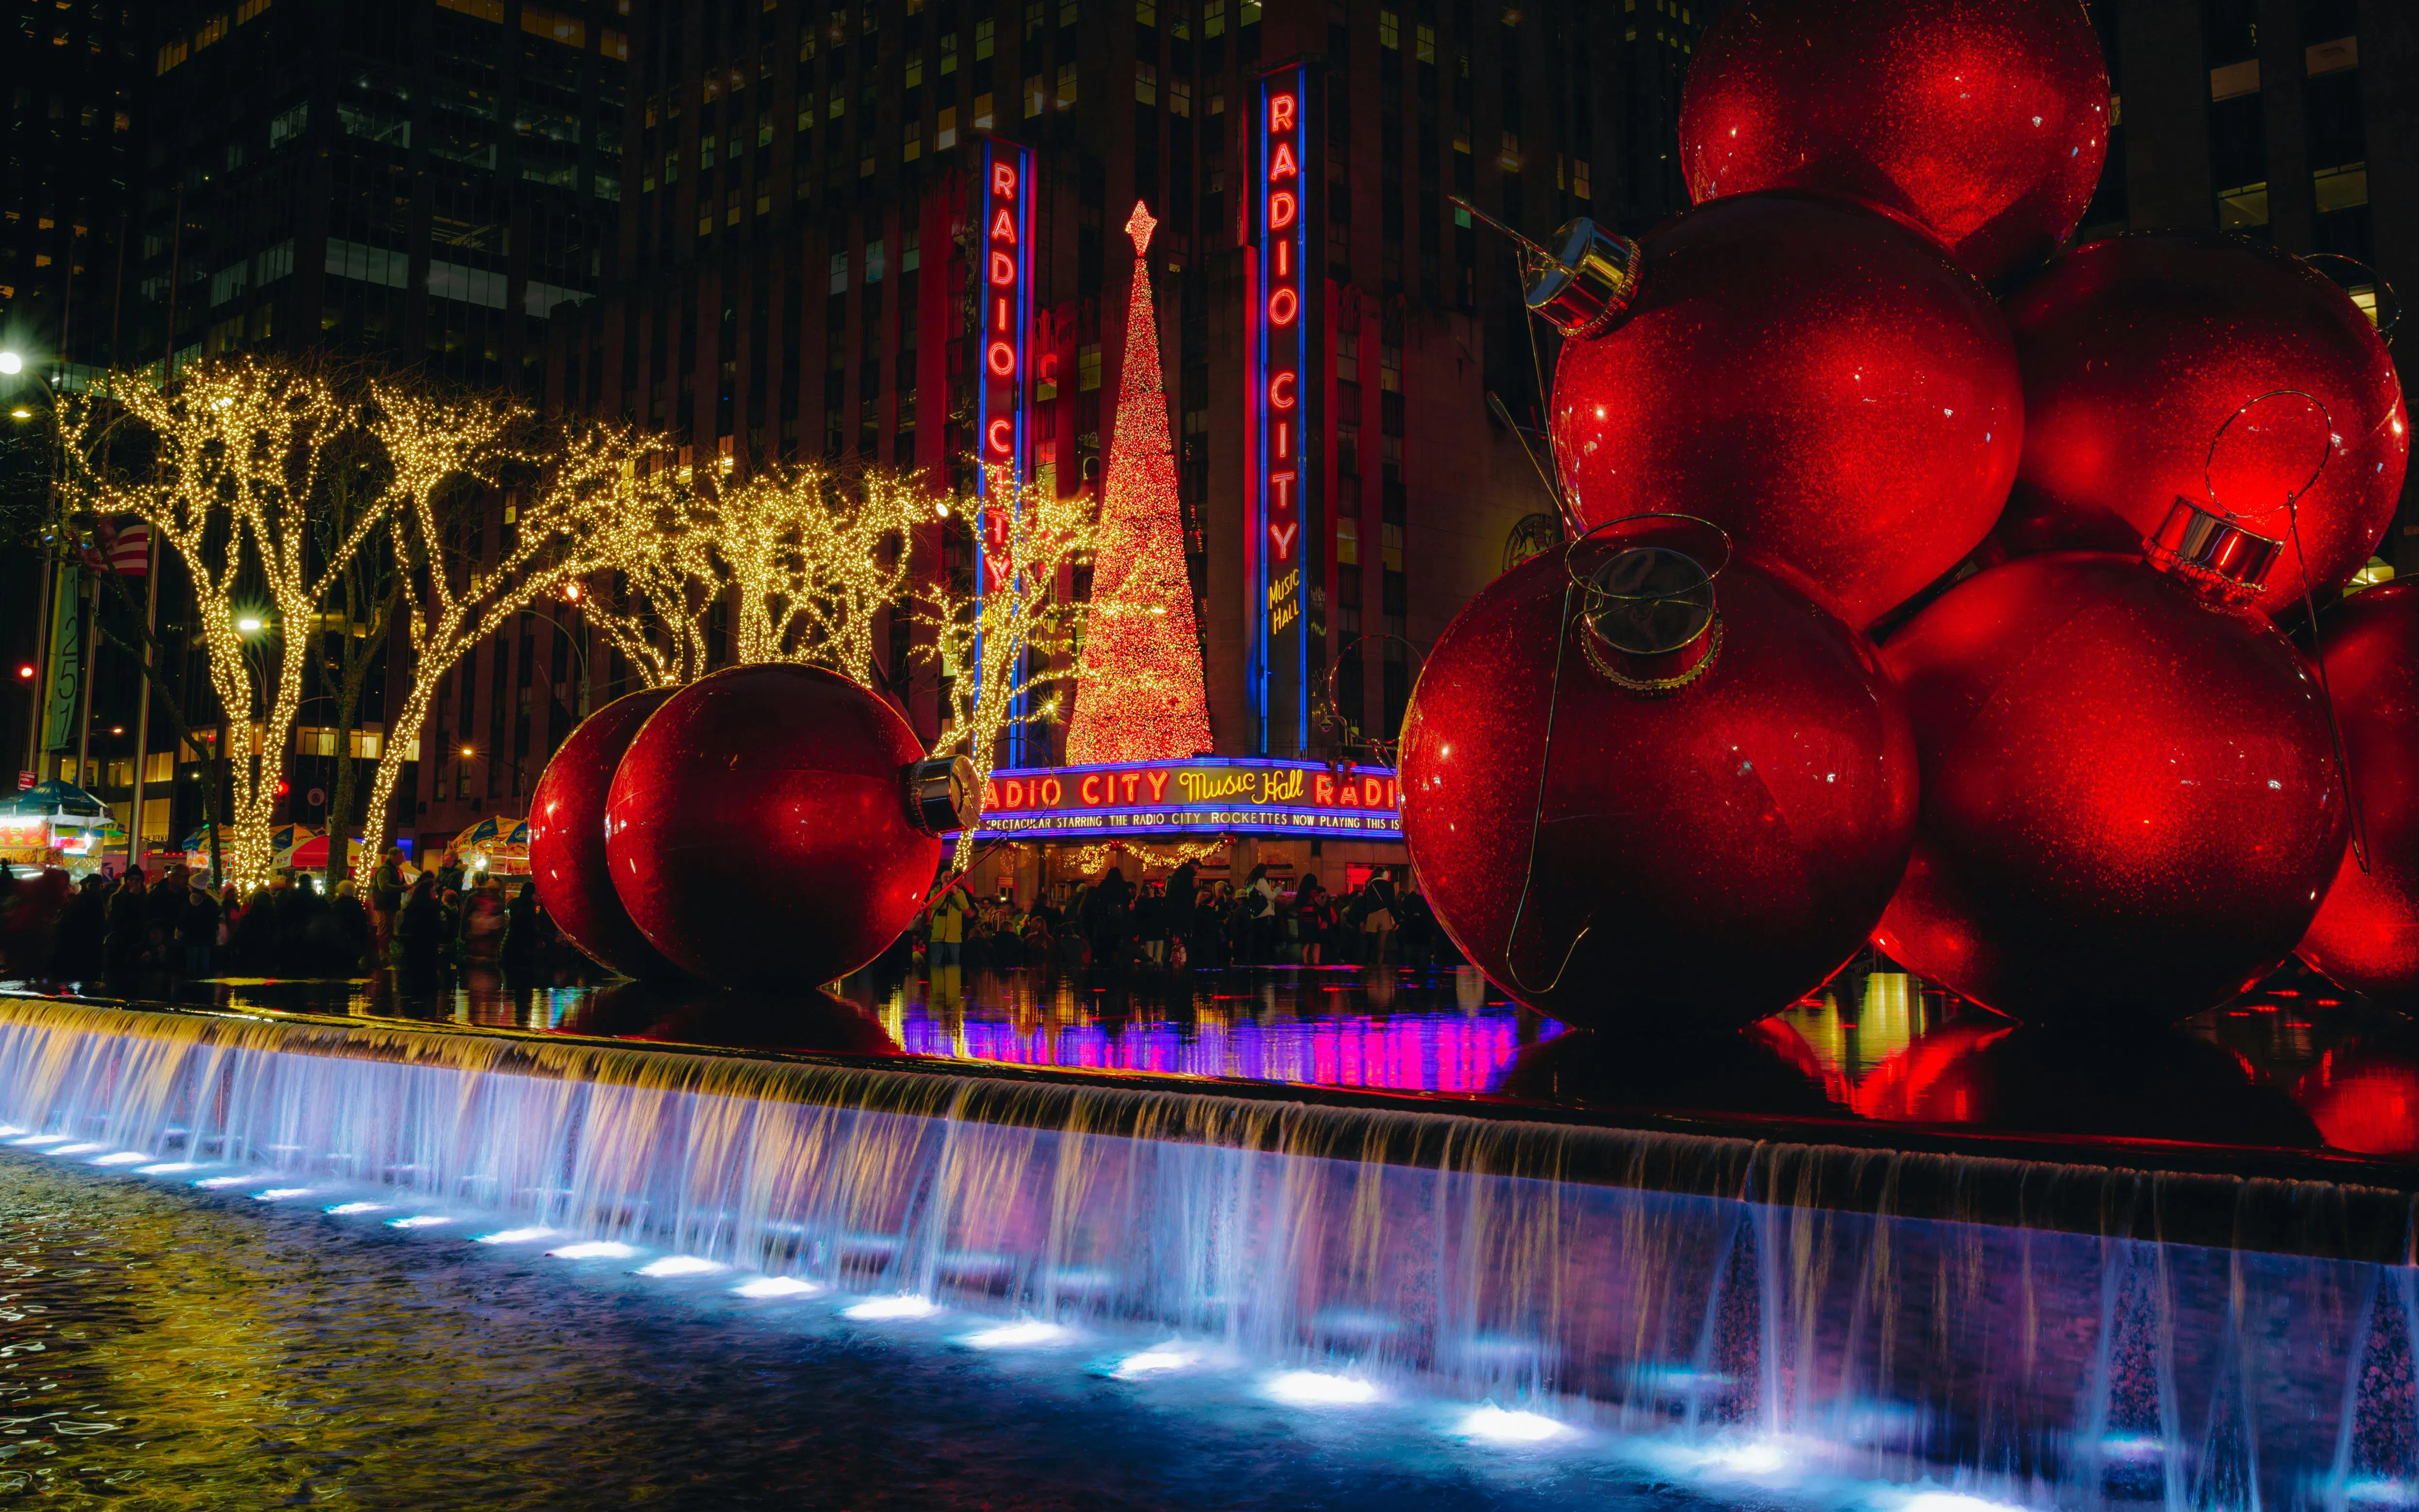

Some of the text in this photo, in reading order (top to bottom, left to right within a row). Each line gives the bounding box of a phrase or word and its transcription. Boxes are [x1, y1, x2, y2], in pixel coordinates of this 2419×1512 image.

[989, 163, 1015, 375] RADIO
[1270, 95, 1297, 559] RADIO CITY
[985, 420, 1011, 590] CITY
[1269, 568, 1299, 609] MUSIC
[1272, 599, 1300, 635] HALL
[59, 571, 78, 743] 1251
[983, 769, 1394, 808] ADIO CITY Music Hall RADI
[986, 818, 1051, 830] SPECTACULAR
[1057, 816, 1102, 828] STARRING
[1109, 814, 1128, 826] THE
[1133, 813, 1165, 825] RADIO
[1171, 812, 1201, 825] CITY
[1211, 812, 1287, 825] ROCKETTES
[1293, 814, 1315, 826] NOW
[1320, 816, 1360, 828] PLAYING
[1366, 818, 1386, 829] THIS
